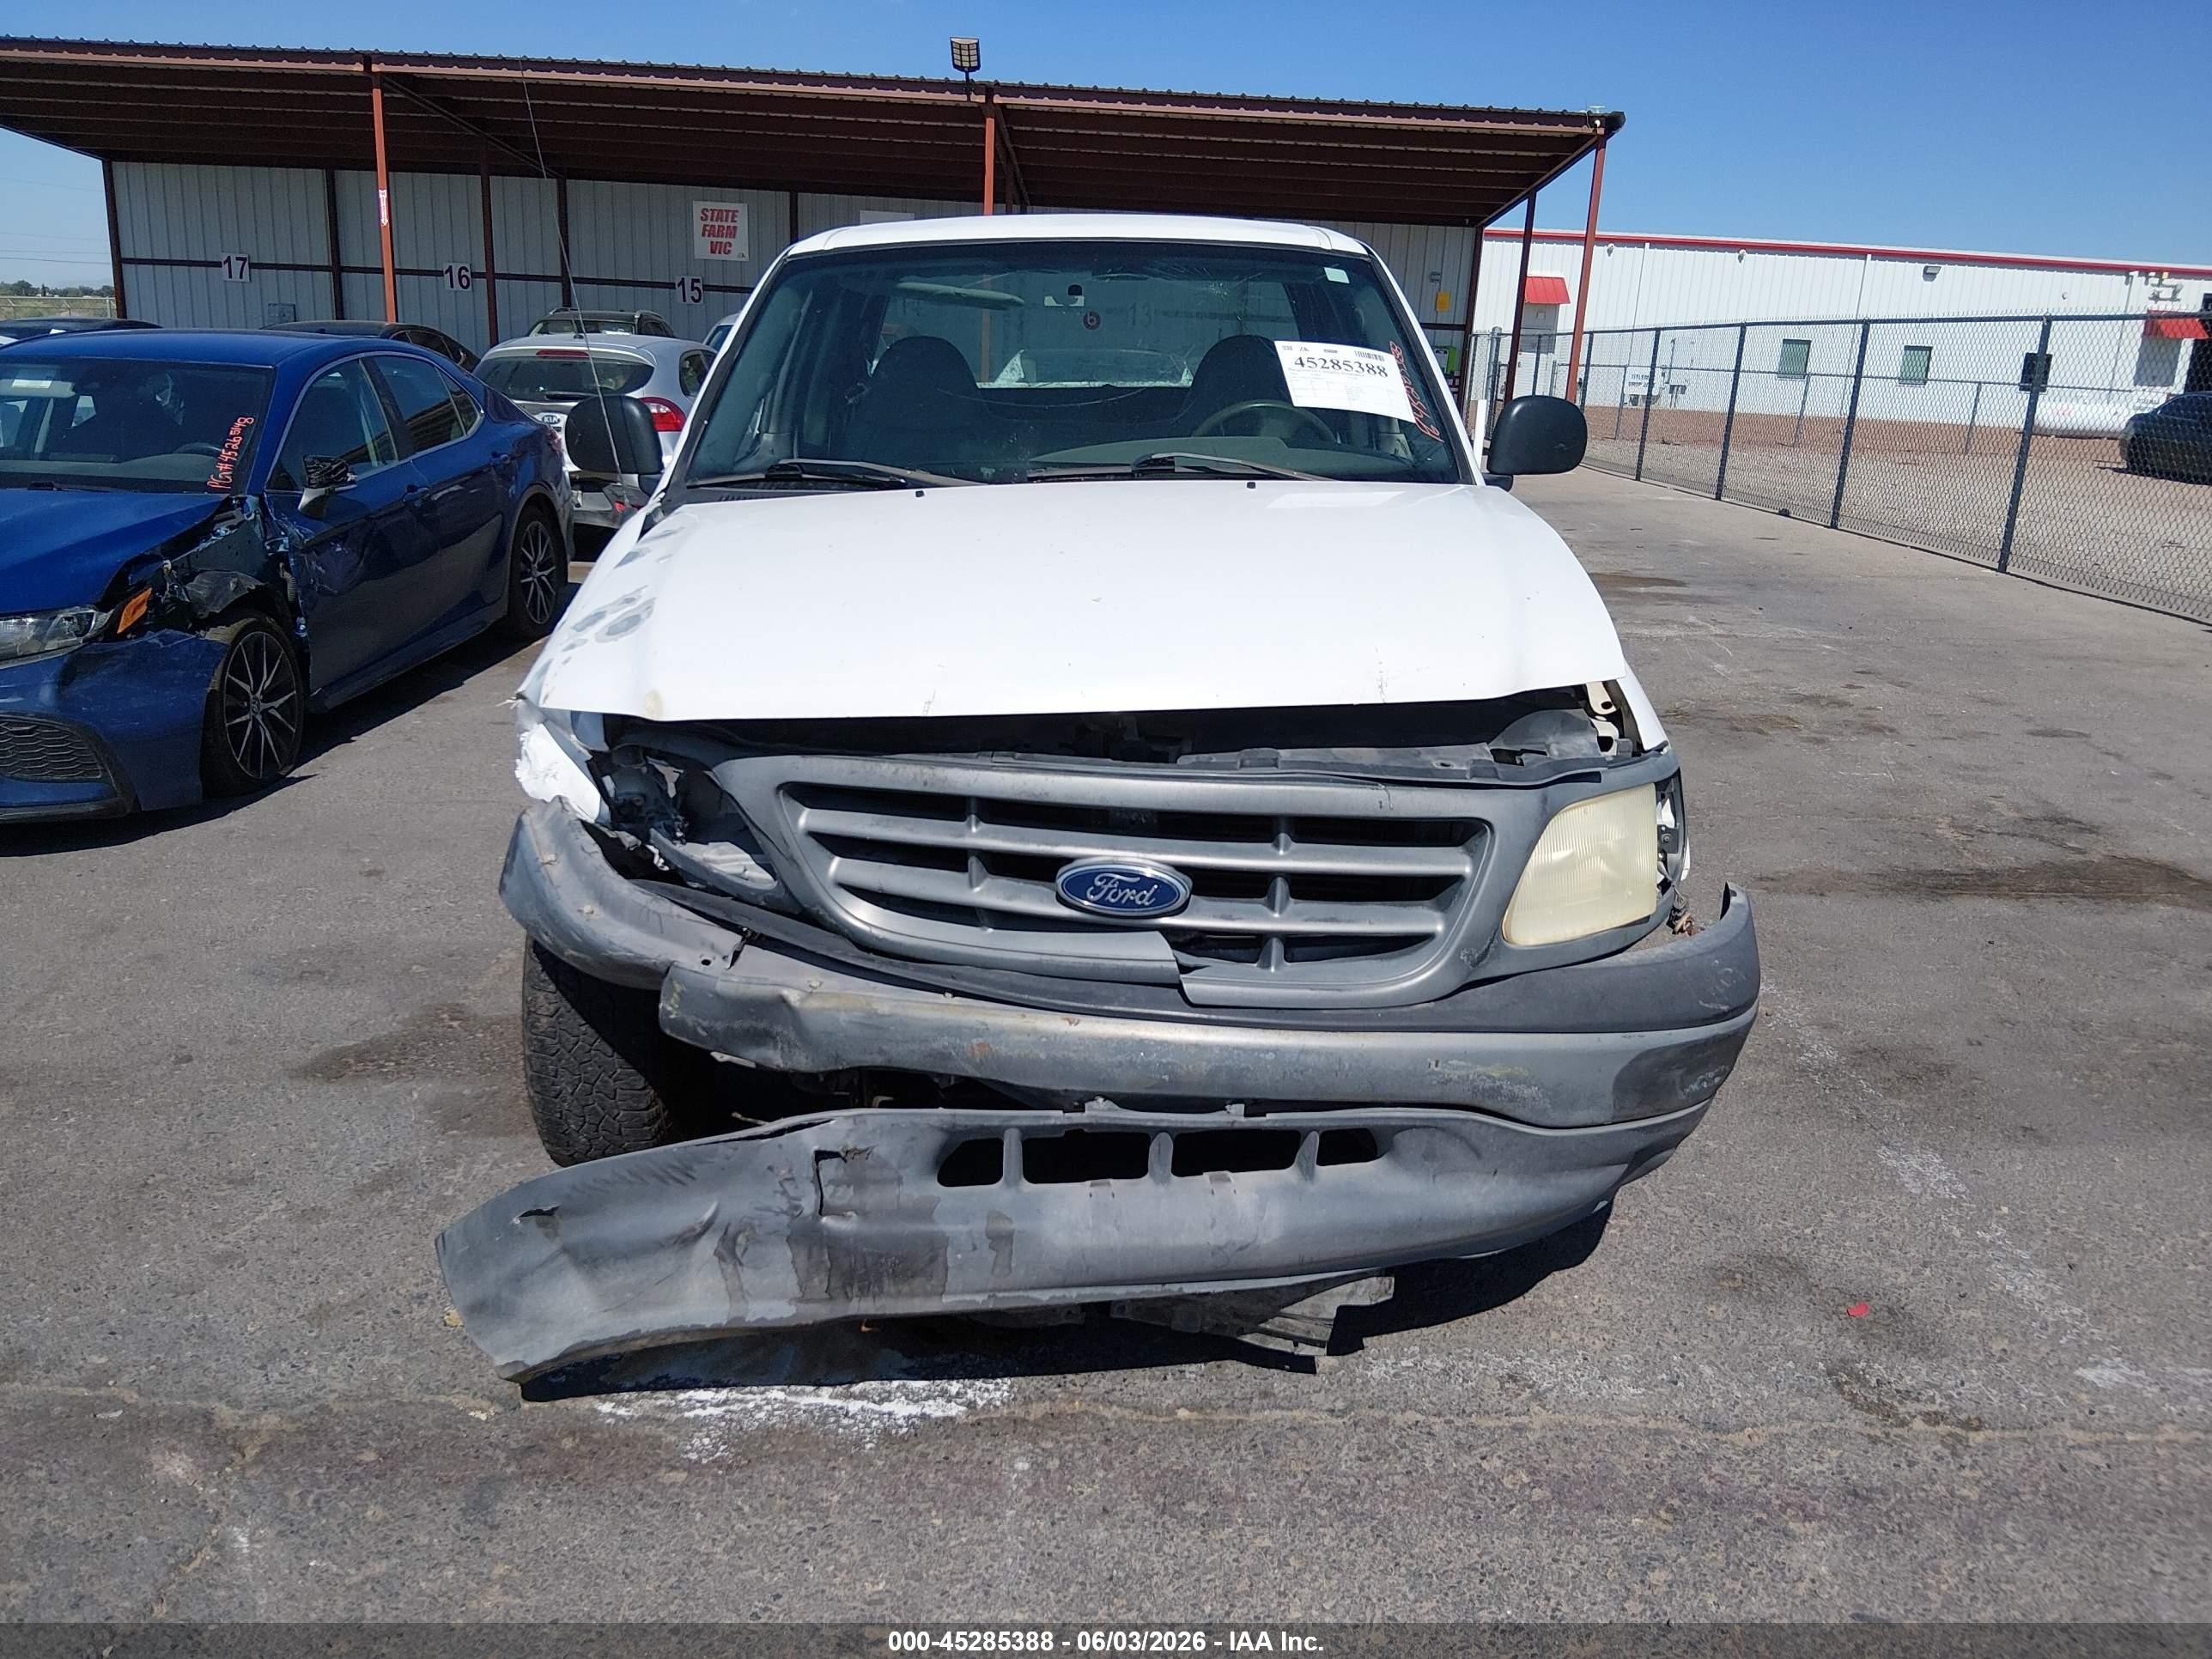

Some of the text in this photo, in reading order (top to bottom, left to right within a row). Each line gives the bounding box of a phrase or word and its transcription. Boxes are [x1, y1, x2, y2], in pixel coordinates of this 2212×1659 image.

[700, 208, 739, 222] STATE
[701, 224, 738, 239] FARM
[709, 240, 732, 255] VIC
[222, 255, 248, 279] 17
[444, 264, 471, 290] 16
[677, 276, 702, 303] 15
[1294, 356, 1389, 378] 45285388
[1085, 872, 1158, 906] Ford
